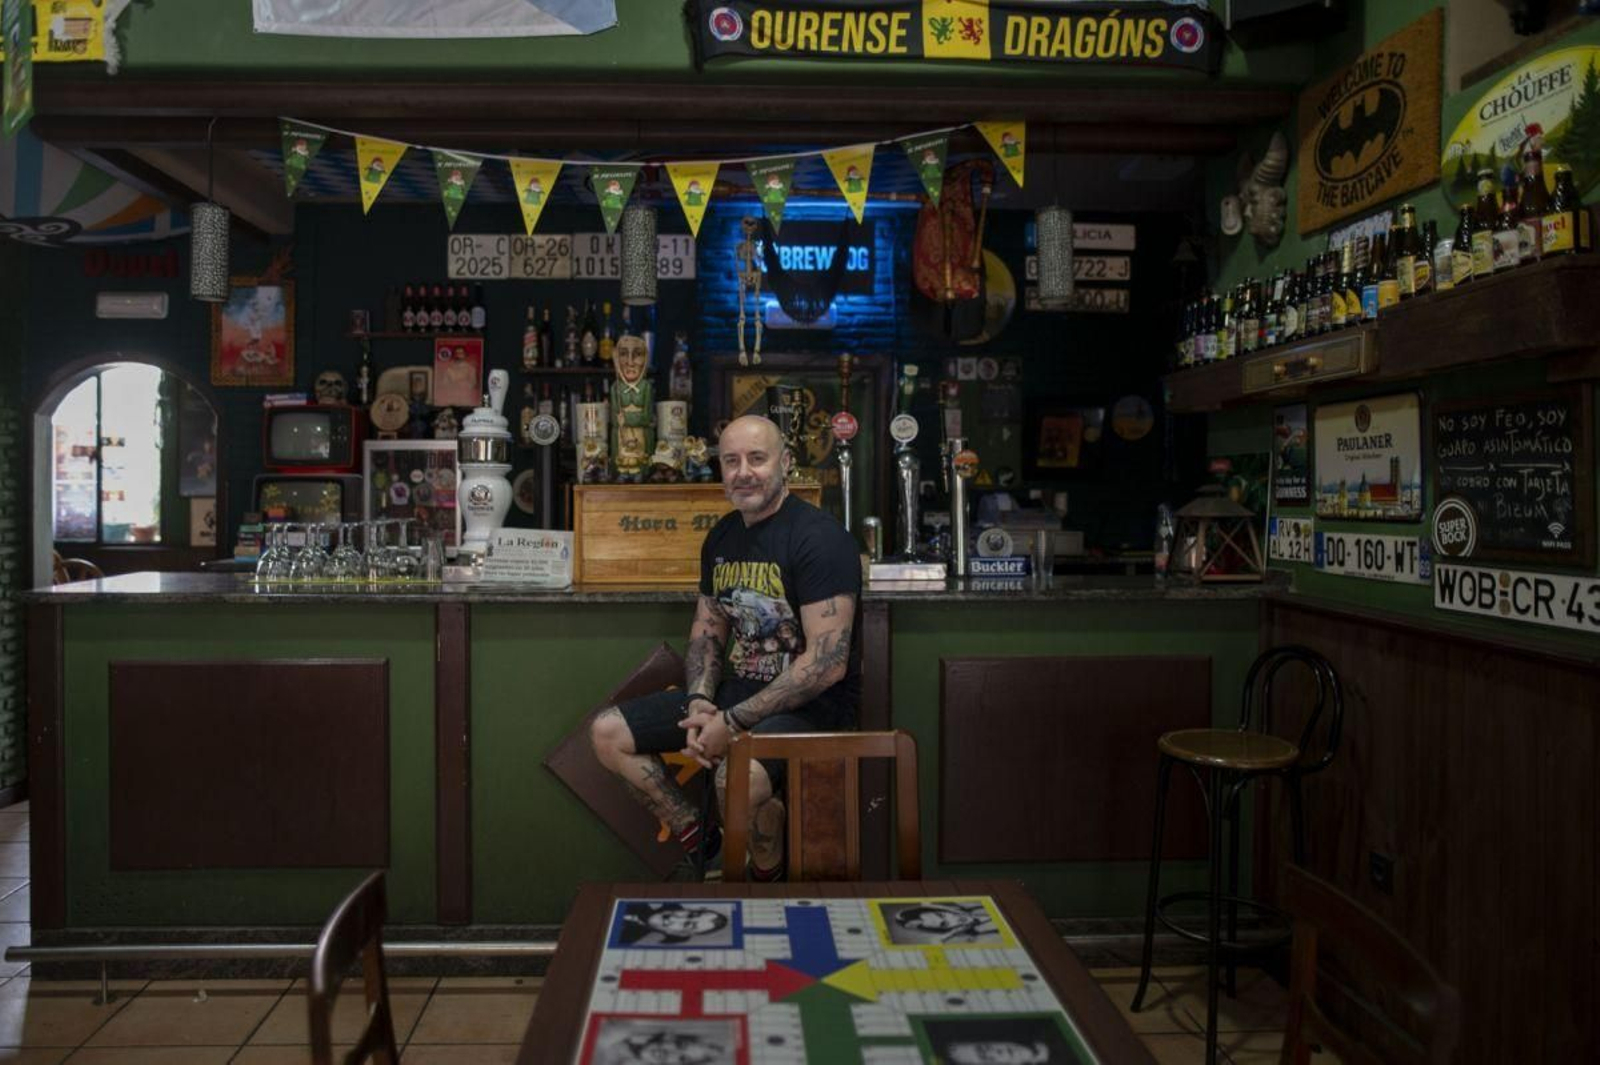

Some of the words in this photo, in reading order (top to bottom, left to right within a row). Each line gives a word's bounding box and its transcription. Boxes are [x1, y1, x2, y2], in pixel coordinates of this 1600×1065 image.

[750, 10, 909, 54] OURENSE
[1005, 11, 1168, 58] DRAGÓNS
[1318, 54, 1384, 118] WELCOME
[1388, 52, 1405, 78] TO
[1517, 74, 1532, 88] LA
[1480, 64, 1573, 121] CHOUFFE
[1317, 180, 1338, 207] THE
[1340, 150, 1403, 206] BATCAVE
[513, 237, 570, 257] OR-26
[456, 257, 503, 276] 2025
[523, 257, 558, 276] 627
[575, 256, 620, 277] 1015
[779, 245, 869, 271] BREWOG
[1462, 413, 1487, 433] SOY
[1537, 406, 1568, 427] SOY
[1337, 433, 1393, 451] PAULANER
[1437, 438, 1477, 459] GUAPO
[1457, 476, 1490, 489] COBRO
[1495, 476, 1517, 489] CON
[1518, 469, 1570, 502] TARJETA
[1493, 492, 1550, 520] BIZUM
[619, 515, 677, 532] Hora
[1438, 517, 1469, 533] SUPER
[498, 537, 514, 546] La
[517, 538, 559, 550] Región
[1441, 530, 1469, 546] BOCK
[970, 560, 1025, 574] Buckler
[713, 561, 786, 600] GOONIES
